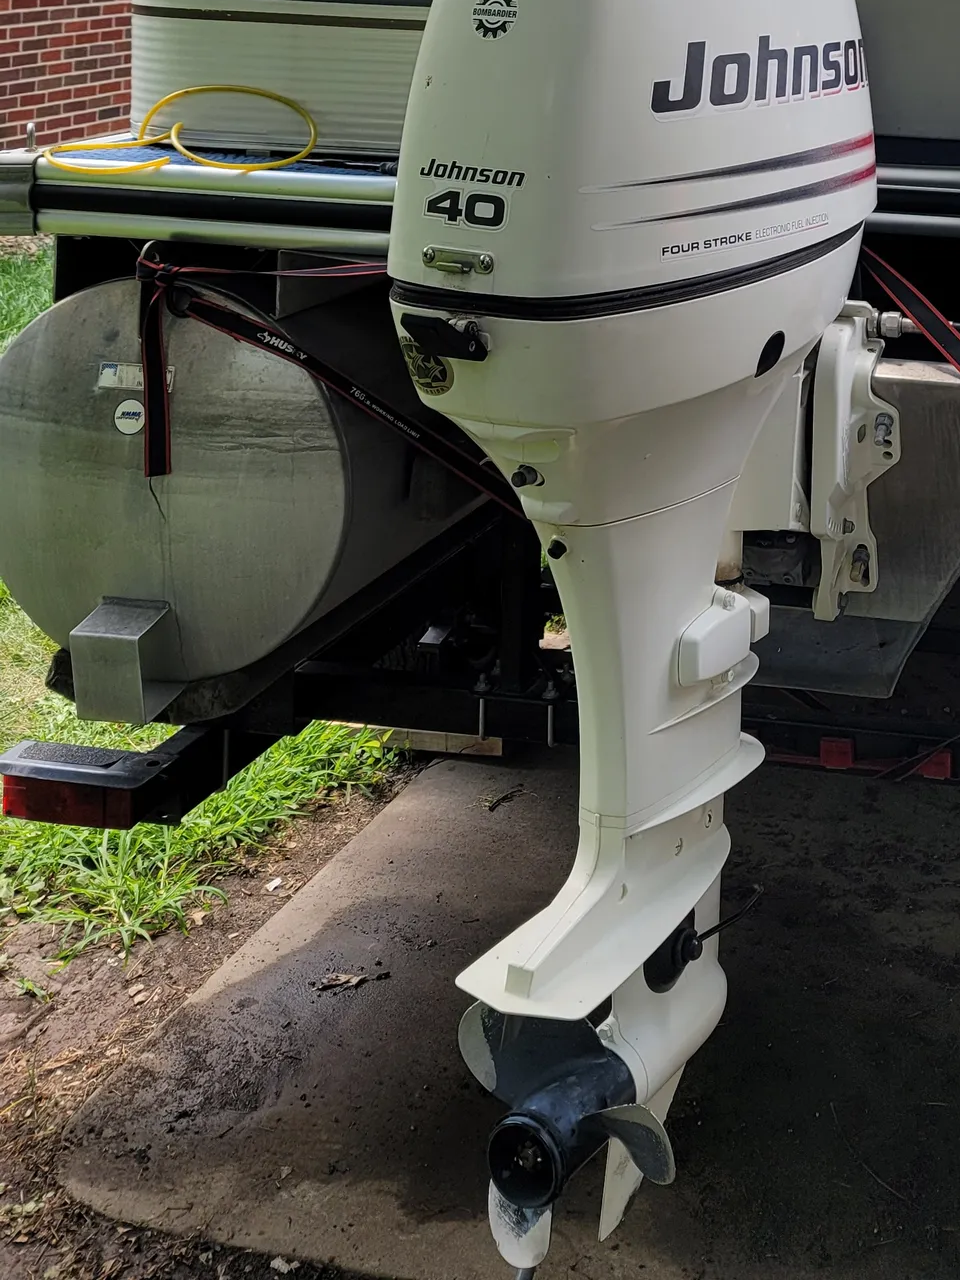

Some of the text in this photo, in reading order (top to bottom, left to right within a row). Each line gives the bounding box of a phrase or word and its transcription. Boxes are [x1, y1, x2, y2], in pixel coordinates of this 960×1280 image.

[472, 8, 518, 19] BOMBARDIER
[419, 158, 526, 187] Johnson
[425, 189, 507, 228] 40
[661, 212, 829, 257] FOUR STROKE ELECTRONIC FUEL INJECTION
[371, 404, 395, 422] WORKING
[394, 420, 408, 431] LOAD
[407, 427, 421, 439] LIMIT
